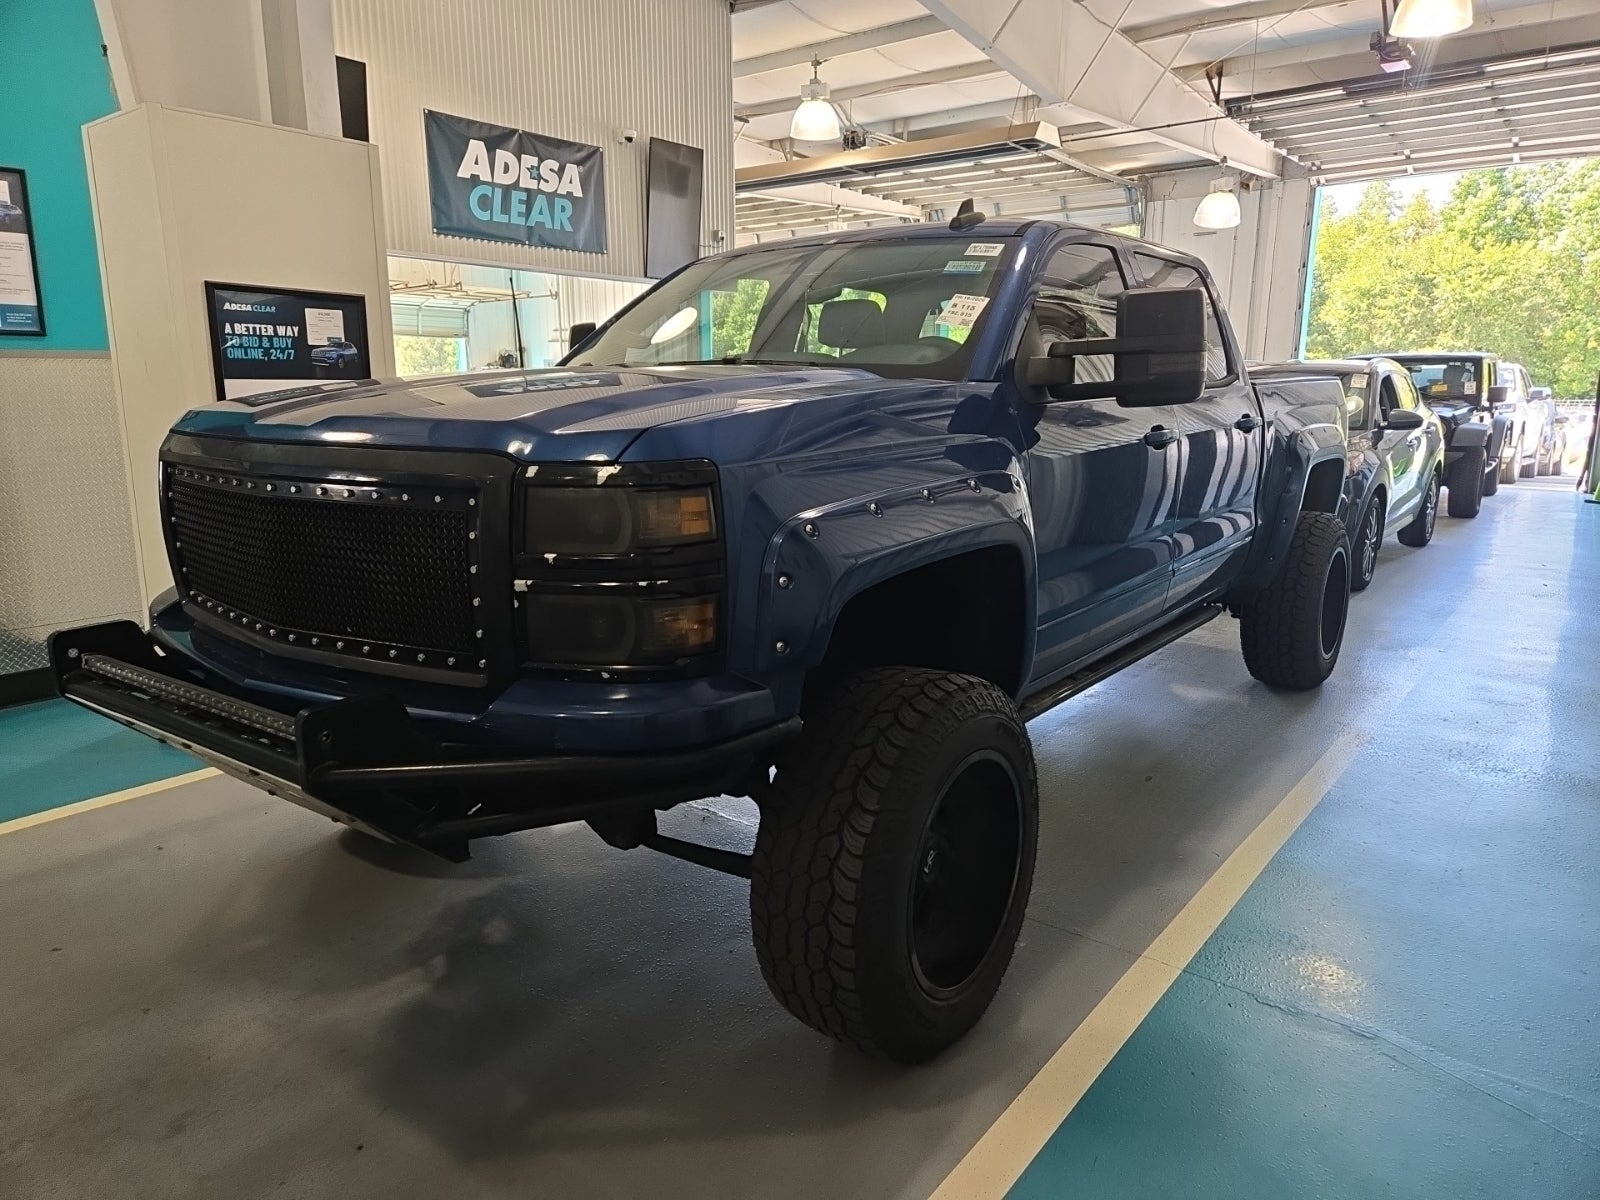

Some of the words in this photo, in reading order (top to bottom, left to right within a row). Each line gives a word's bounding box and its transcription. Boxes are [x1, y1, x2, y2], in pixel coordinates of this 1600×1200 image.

[457, 139, 583, 198] ADESA
[469, 184, 574, 232] CLEAR
[223, 302, 252, 312] ADESA
[253, 304, 276, 313] CLEAR
[225, 323, 233, 334] A
[234, 323, 274, 336] BETTER
[276, 325, 299, 337] WAY
[226, 336, 240, 346] TO
[243, 336, 260, 348] BID
[262, 337, 270, 348] &
[272, 337, 293, 349] BUY
[227, 347, 268, 361] ONLINE,
[269, 348, 295, 360] 24/7
